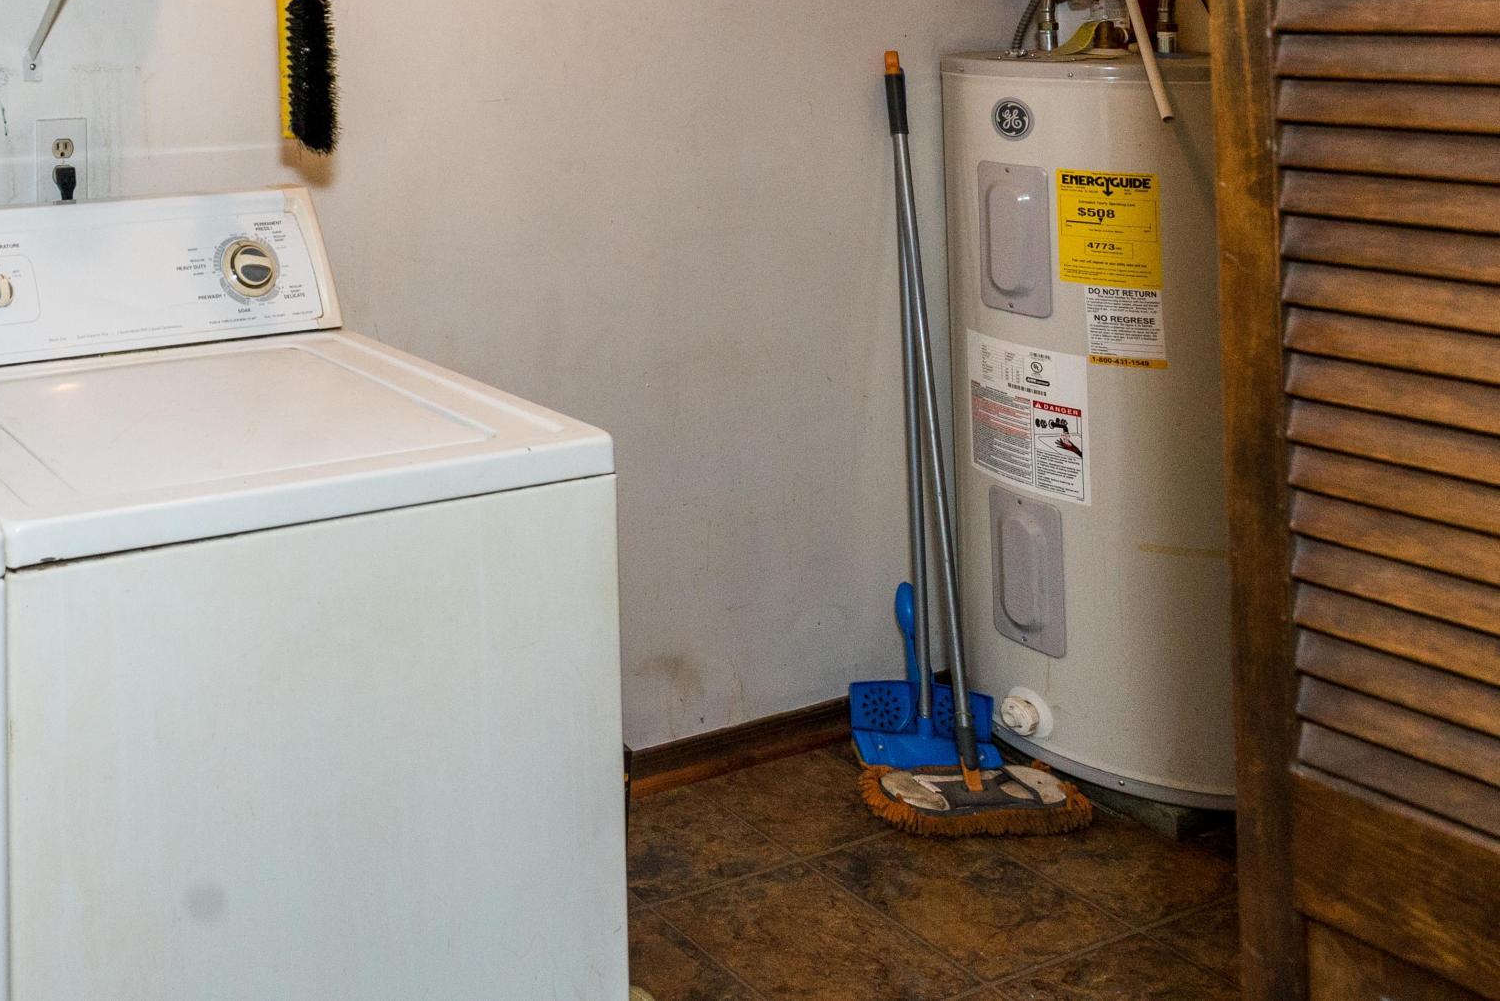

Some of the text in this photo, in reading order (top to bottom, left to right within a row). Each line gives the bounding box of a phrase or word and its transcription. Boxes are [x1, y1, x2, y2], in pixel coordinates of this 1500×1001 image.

[1077, 207, 1116, 218] $508
[1122, 290, 1157, 298] RETURN
[1043, 404, 1079, 416] DANGER
